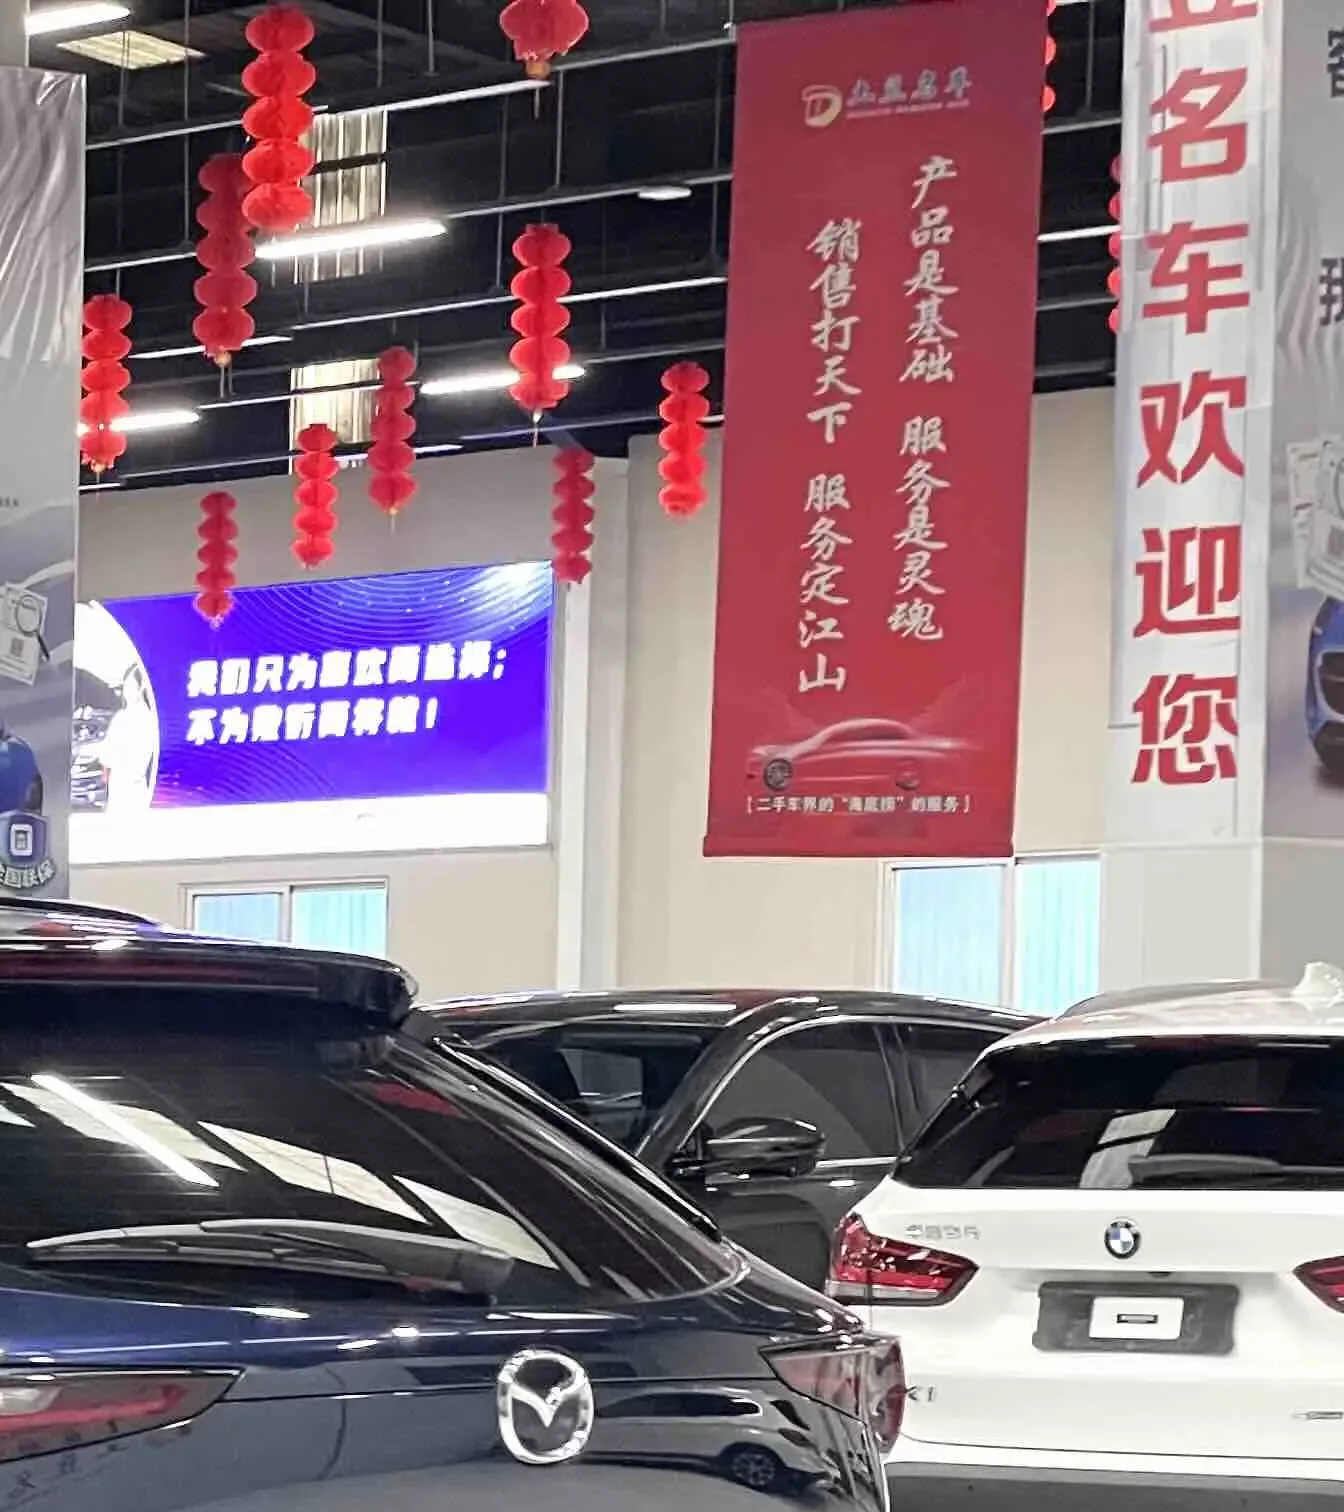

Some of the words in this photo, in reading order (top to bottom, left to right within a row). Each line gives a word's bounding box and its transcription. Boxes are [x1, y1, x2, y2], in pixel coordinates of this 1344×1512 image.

[805, 217, 862, 444] 销售打天下
[899, 155, 960, 384] 产品是基础
[797, 471, 853, 695] 服务定江山
[886, 414, 951, 642] 服务是灵魂
